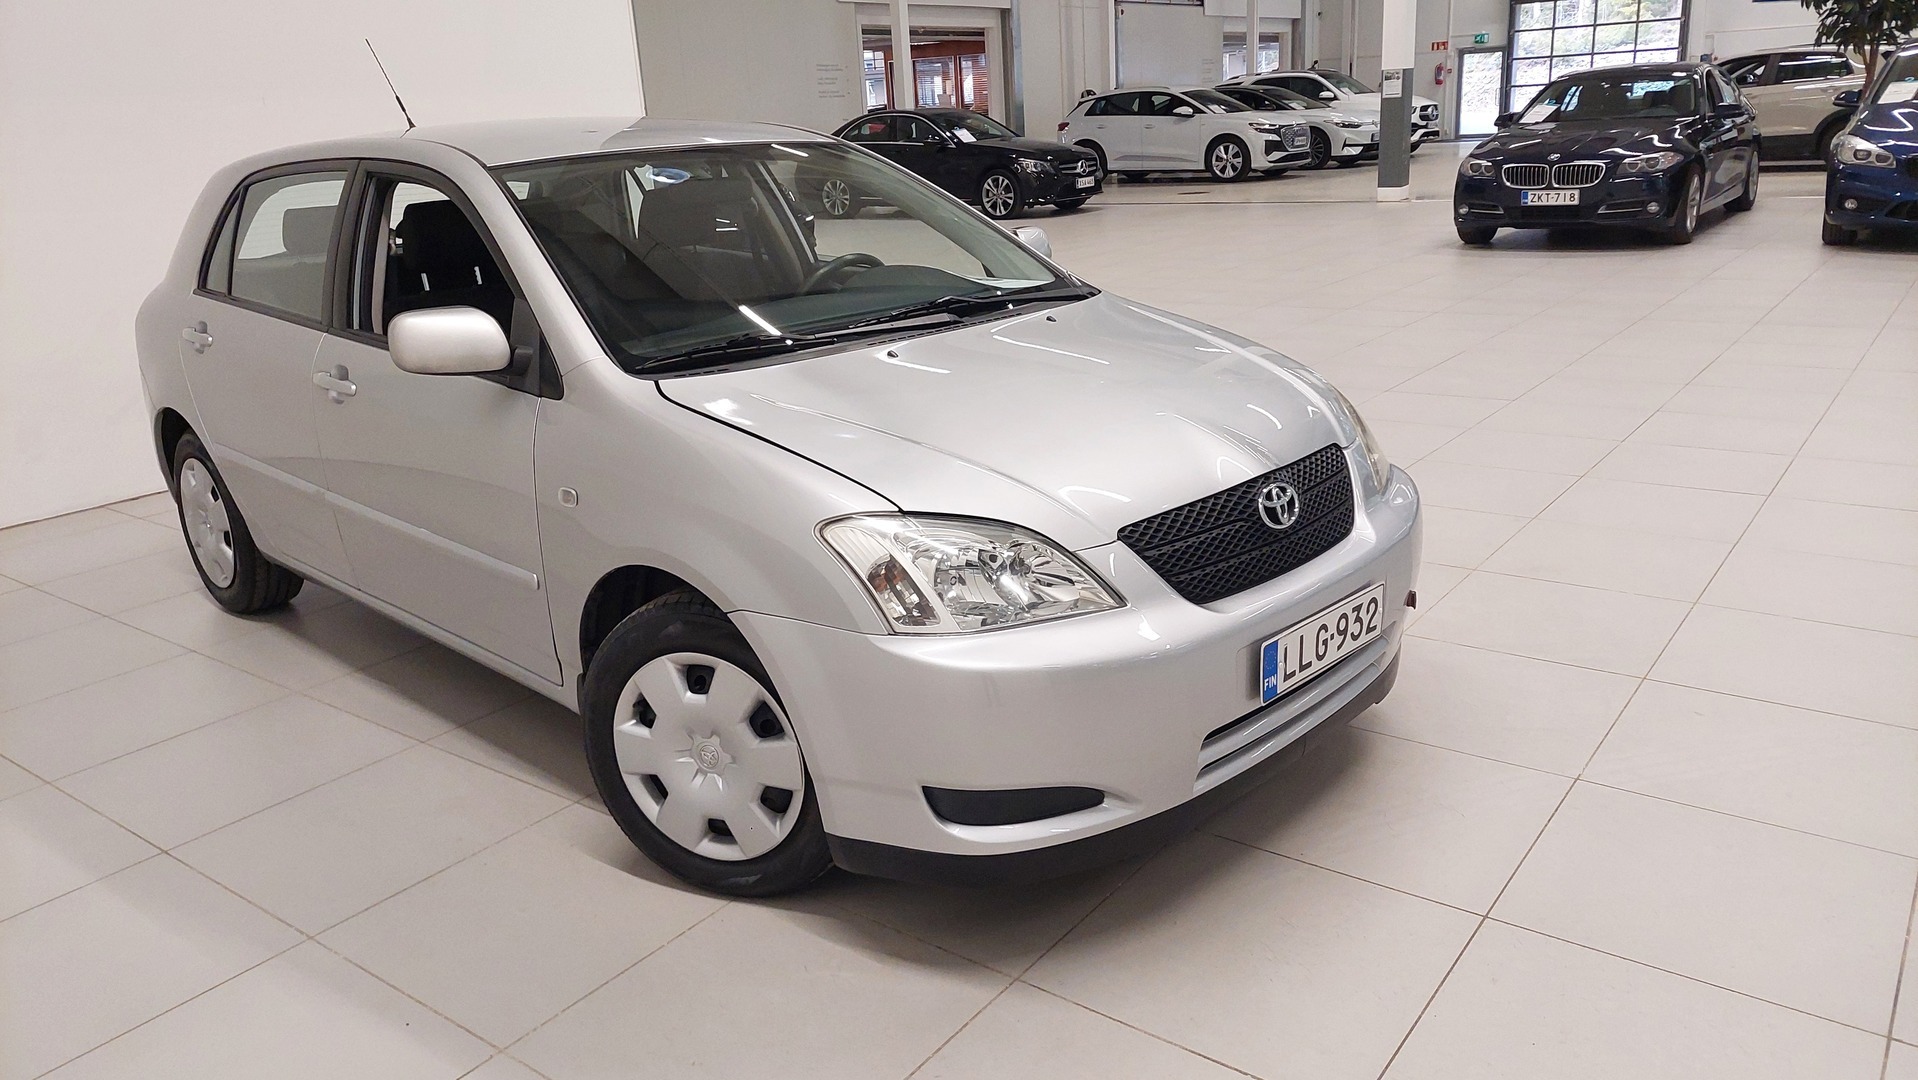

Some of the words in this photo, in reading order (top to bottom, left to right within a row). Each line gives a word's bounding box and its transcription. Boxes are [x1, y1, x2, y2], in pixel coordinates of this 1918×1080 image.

[1530, 193, 1576, 203] ZKT-718
[1283, 597, 1379, 683] LLG-932
[1264, 674, 1277, 691] FIN
